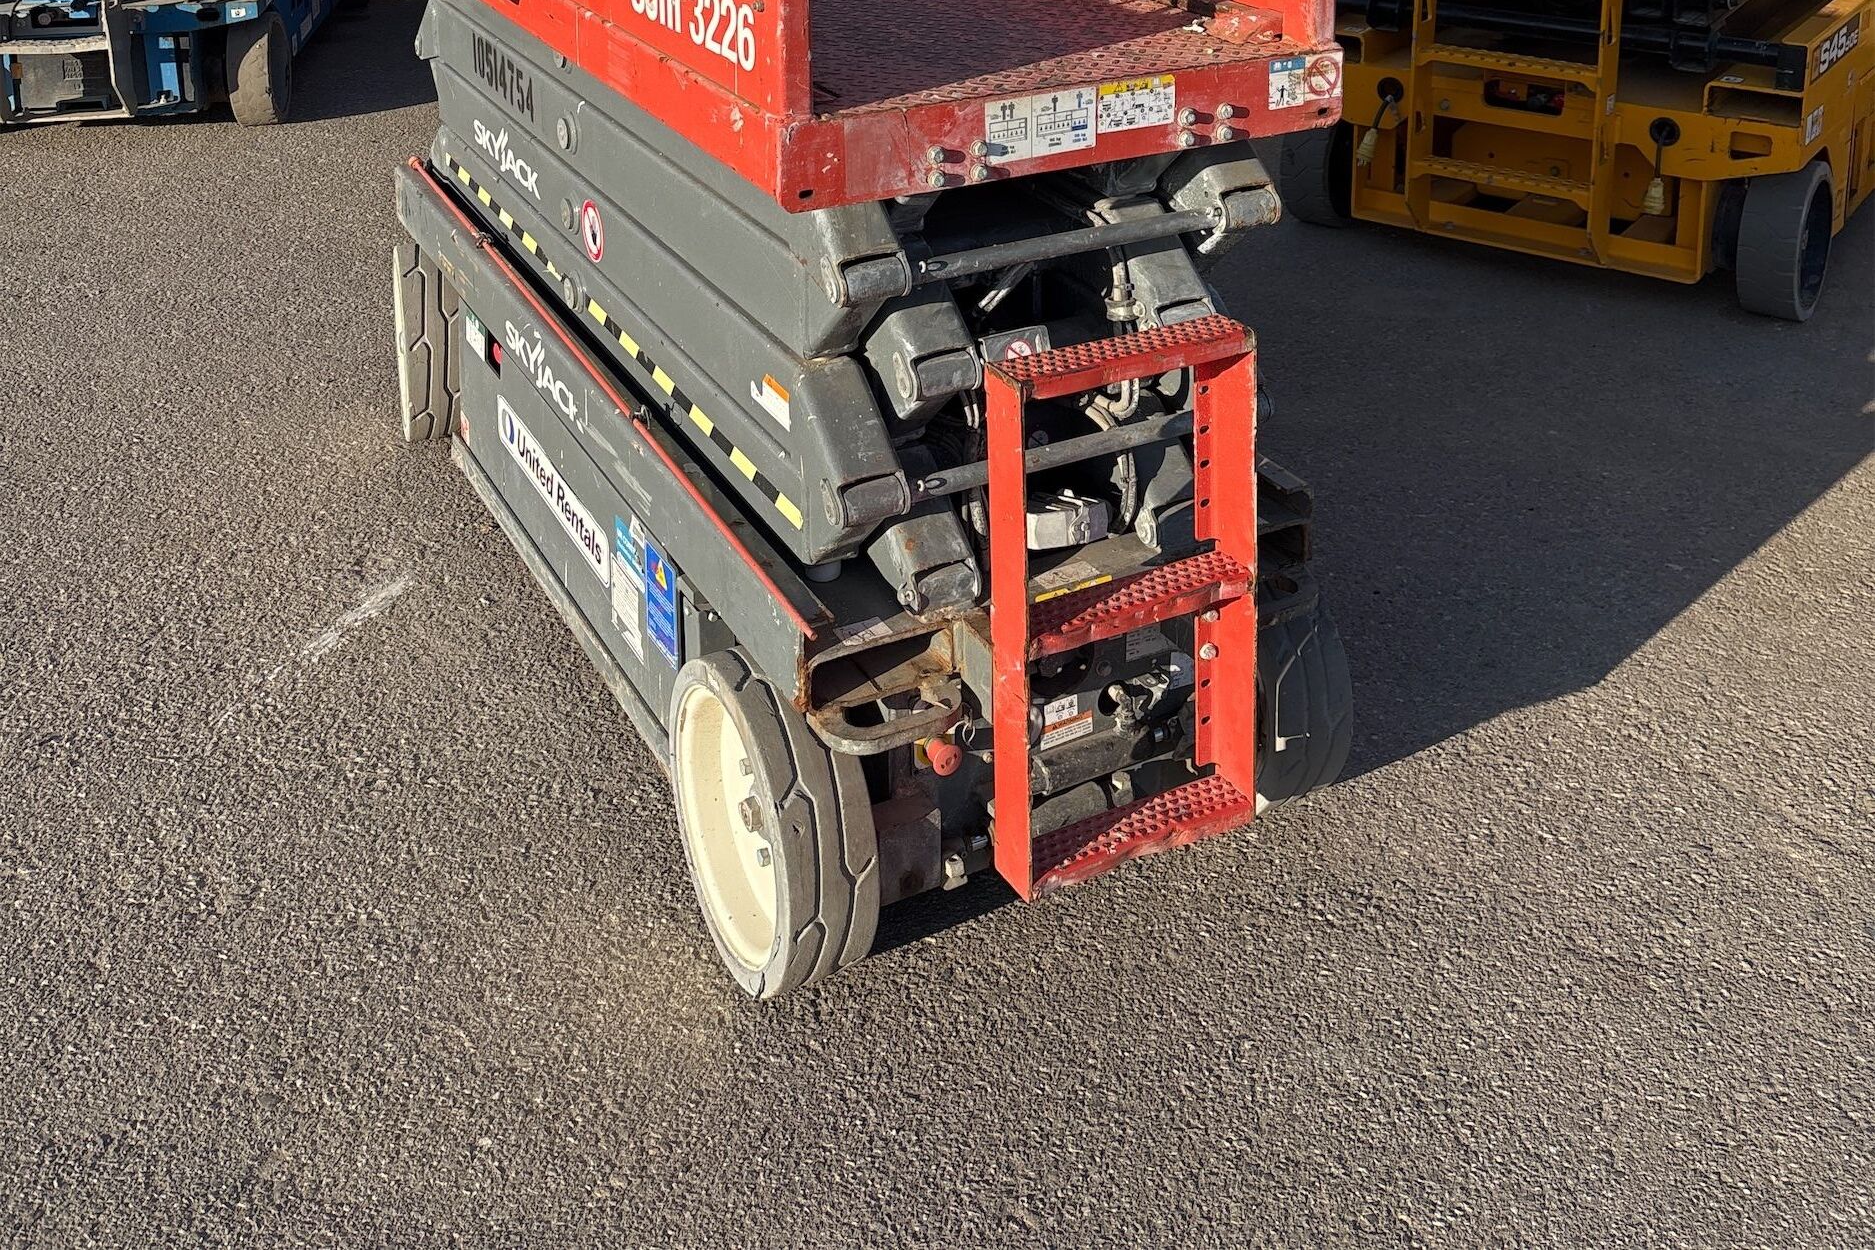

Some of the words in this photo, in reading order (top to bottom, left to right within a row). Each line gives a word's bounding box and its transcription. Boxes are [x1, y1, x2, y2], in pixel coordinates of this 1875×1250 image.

[472, 32, 534, 123] 10514754
[473, 119, 541, 200] SKYJACK
[516, 425, 554, 500] United
[556, 482, 602, 567] Rentals
